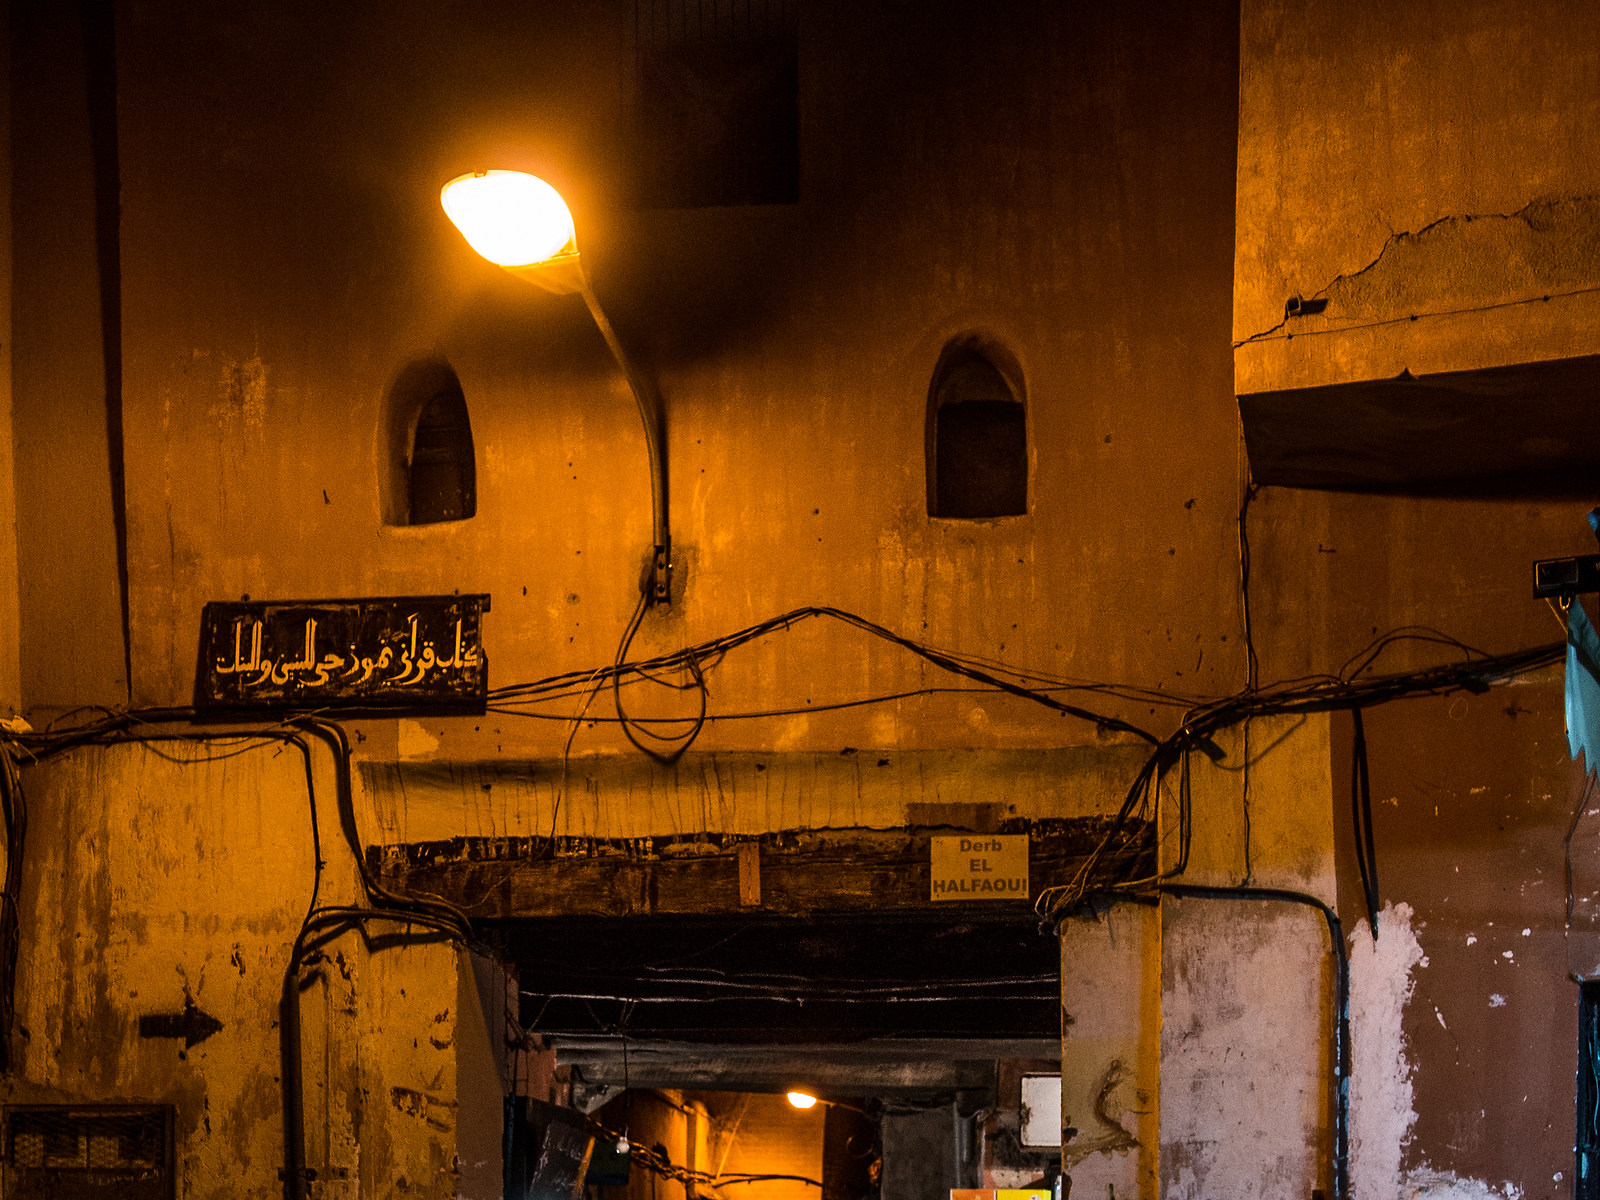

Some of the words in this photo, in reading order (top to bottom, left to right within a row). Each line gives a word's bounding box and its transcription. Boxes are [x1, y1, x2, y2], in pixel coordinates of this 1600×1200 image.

[216, 618, 273, 687] والبنات
[271, 617, 319, 686] للبنين
[435, 617, 482, 674] كتاب
[960, 839, 1002, 852] Derb
[969, 858, 993, 872] EL
[933, 878, 1027, 893] HALFAOUI
